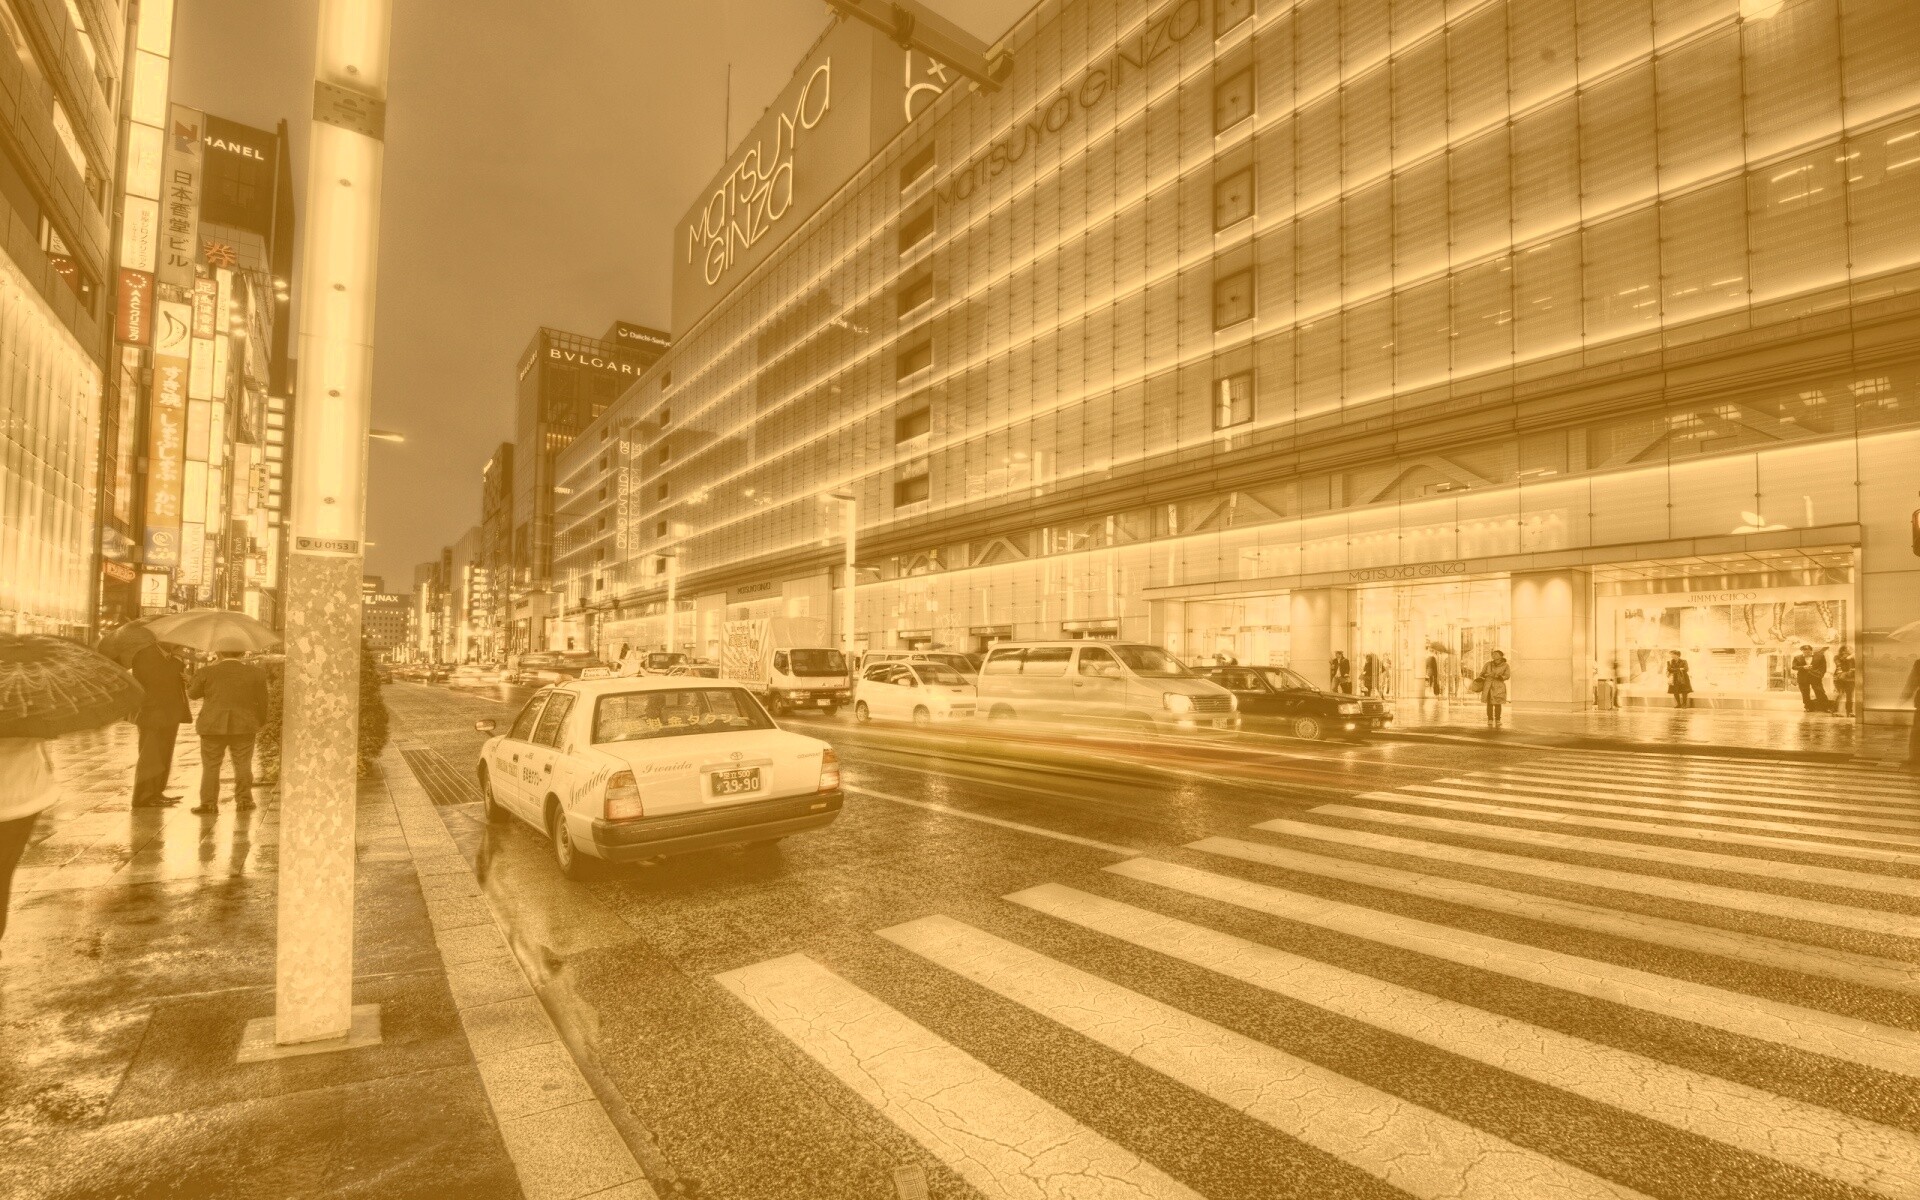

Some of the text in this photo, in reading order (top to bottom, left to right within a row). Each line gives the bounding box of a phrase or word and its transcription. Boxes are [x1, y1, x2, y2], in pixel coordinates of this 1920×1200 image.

[167, 169, 193, 268] 日本香堂ビル
[550, 348, 641, 376] BVLGARI
[314, 541, 349, 551] U 0153
[375, 594, 398, 603] INAX
[1687, 591, 1757, 603] JIMMY CHOO
[642, 760, 693, 774] Iwaida
[737, 769, 751, 778] 500
